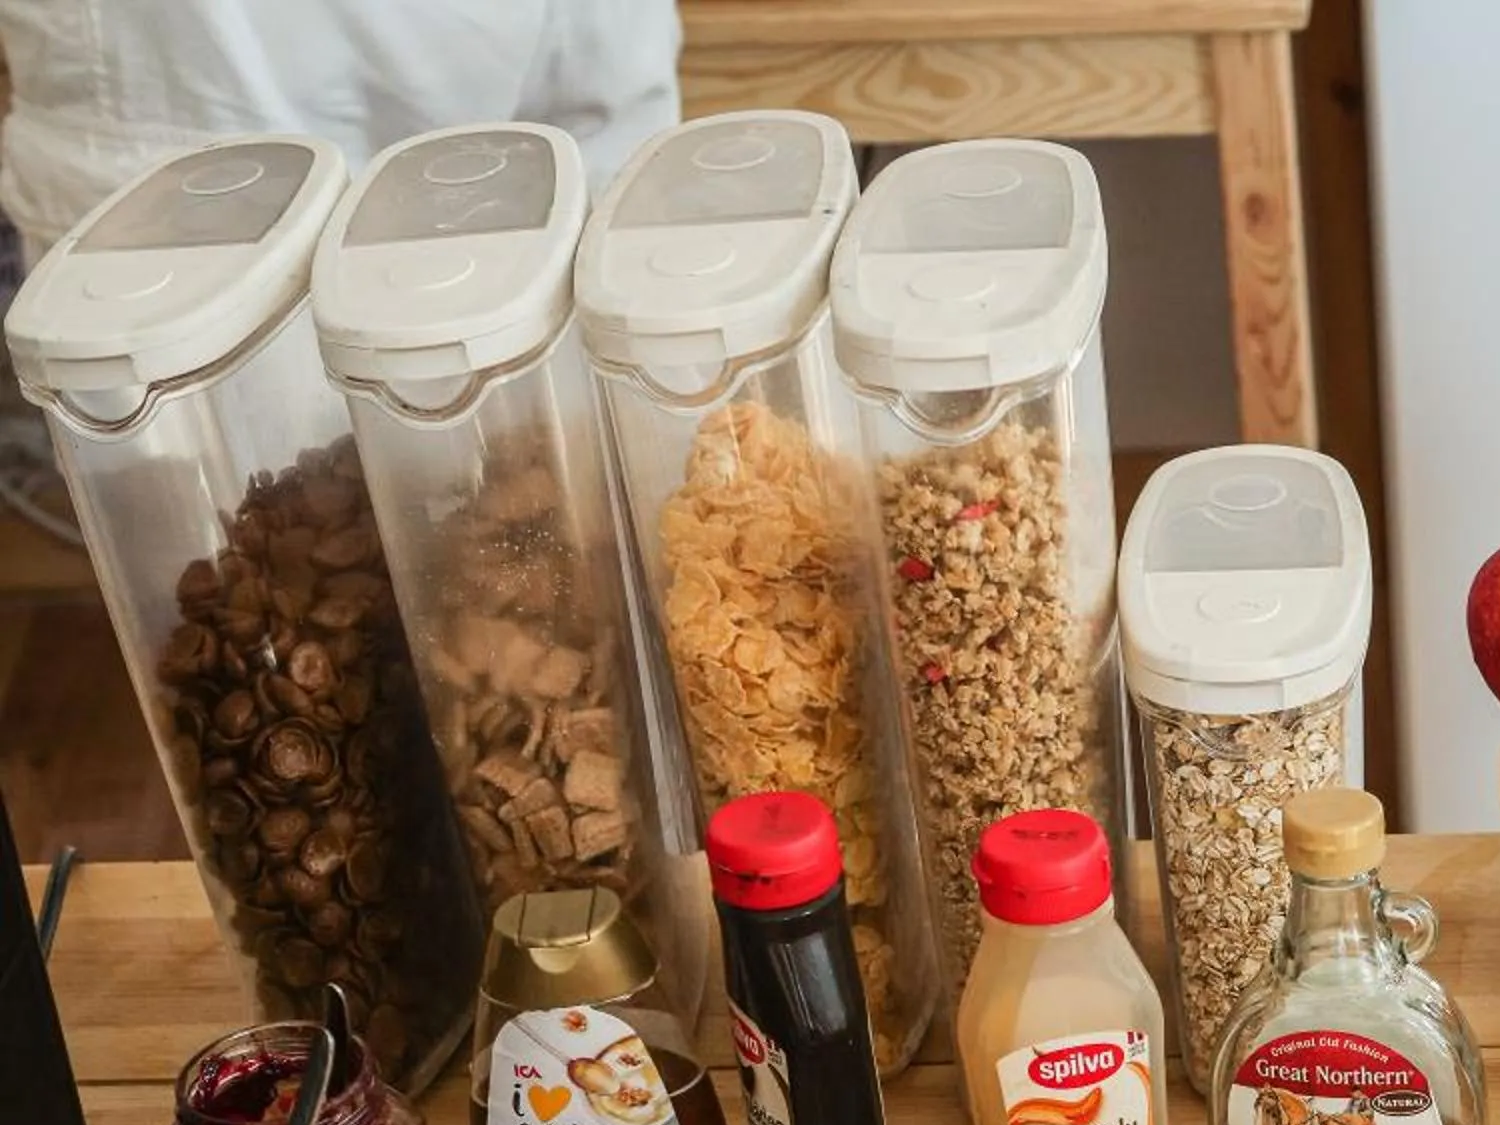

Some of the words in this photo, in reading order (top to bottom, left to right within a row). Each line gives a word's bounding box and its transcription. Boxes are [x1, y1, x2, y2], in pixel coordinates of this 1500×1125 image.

[1271, 1037, 1315, 1057] Original
[1319, 1036, 1339, 1047] Old
[513, 1064, 542, 1079] ICA
[1039, 1050, 1115, 1083] spilva
[1255, 1059, 1309, 1083] Great
[1315, 1065, 1409, 1085] Northern
